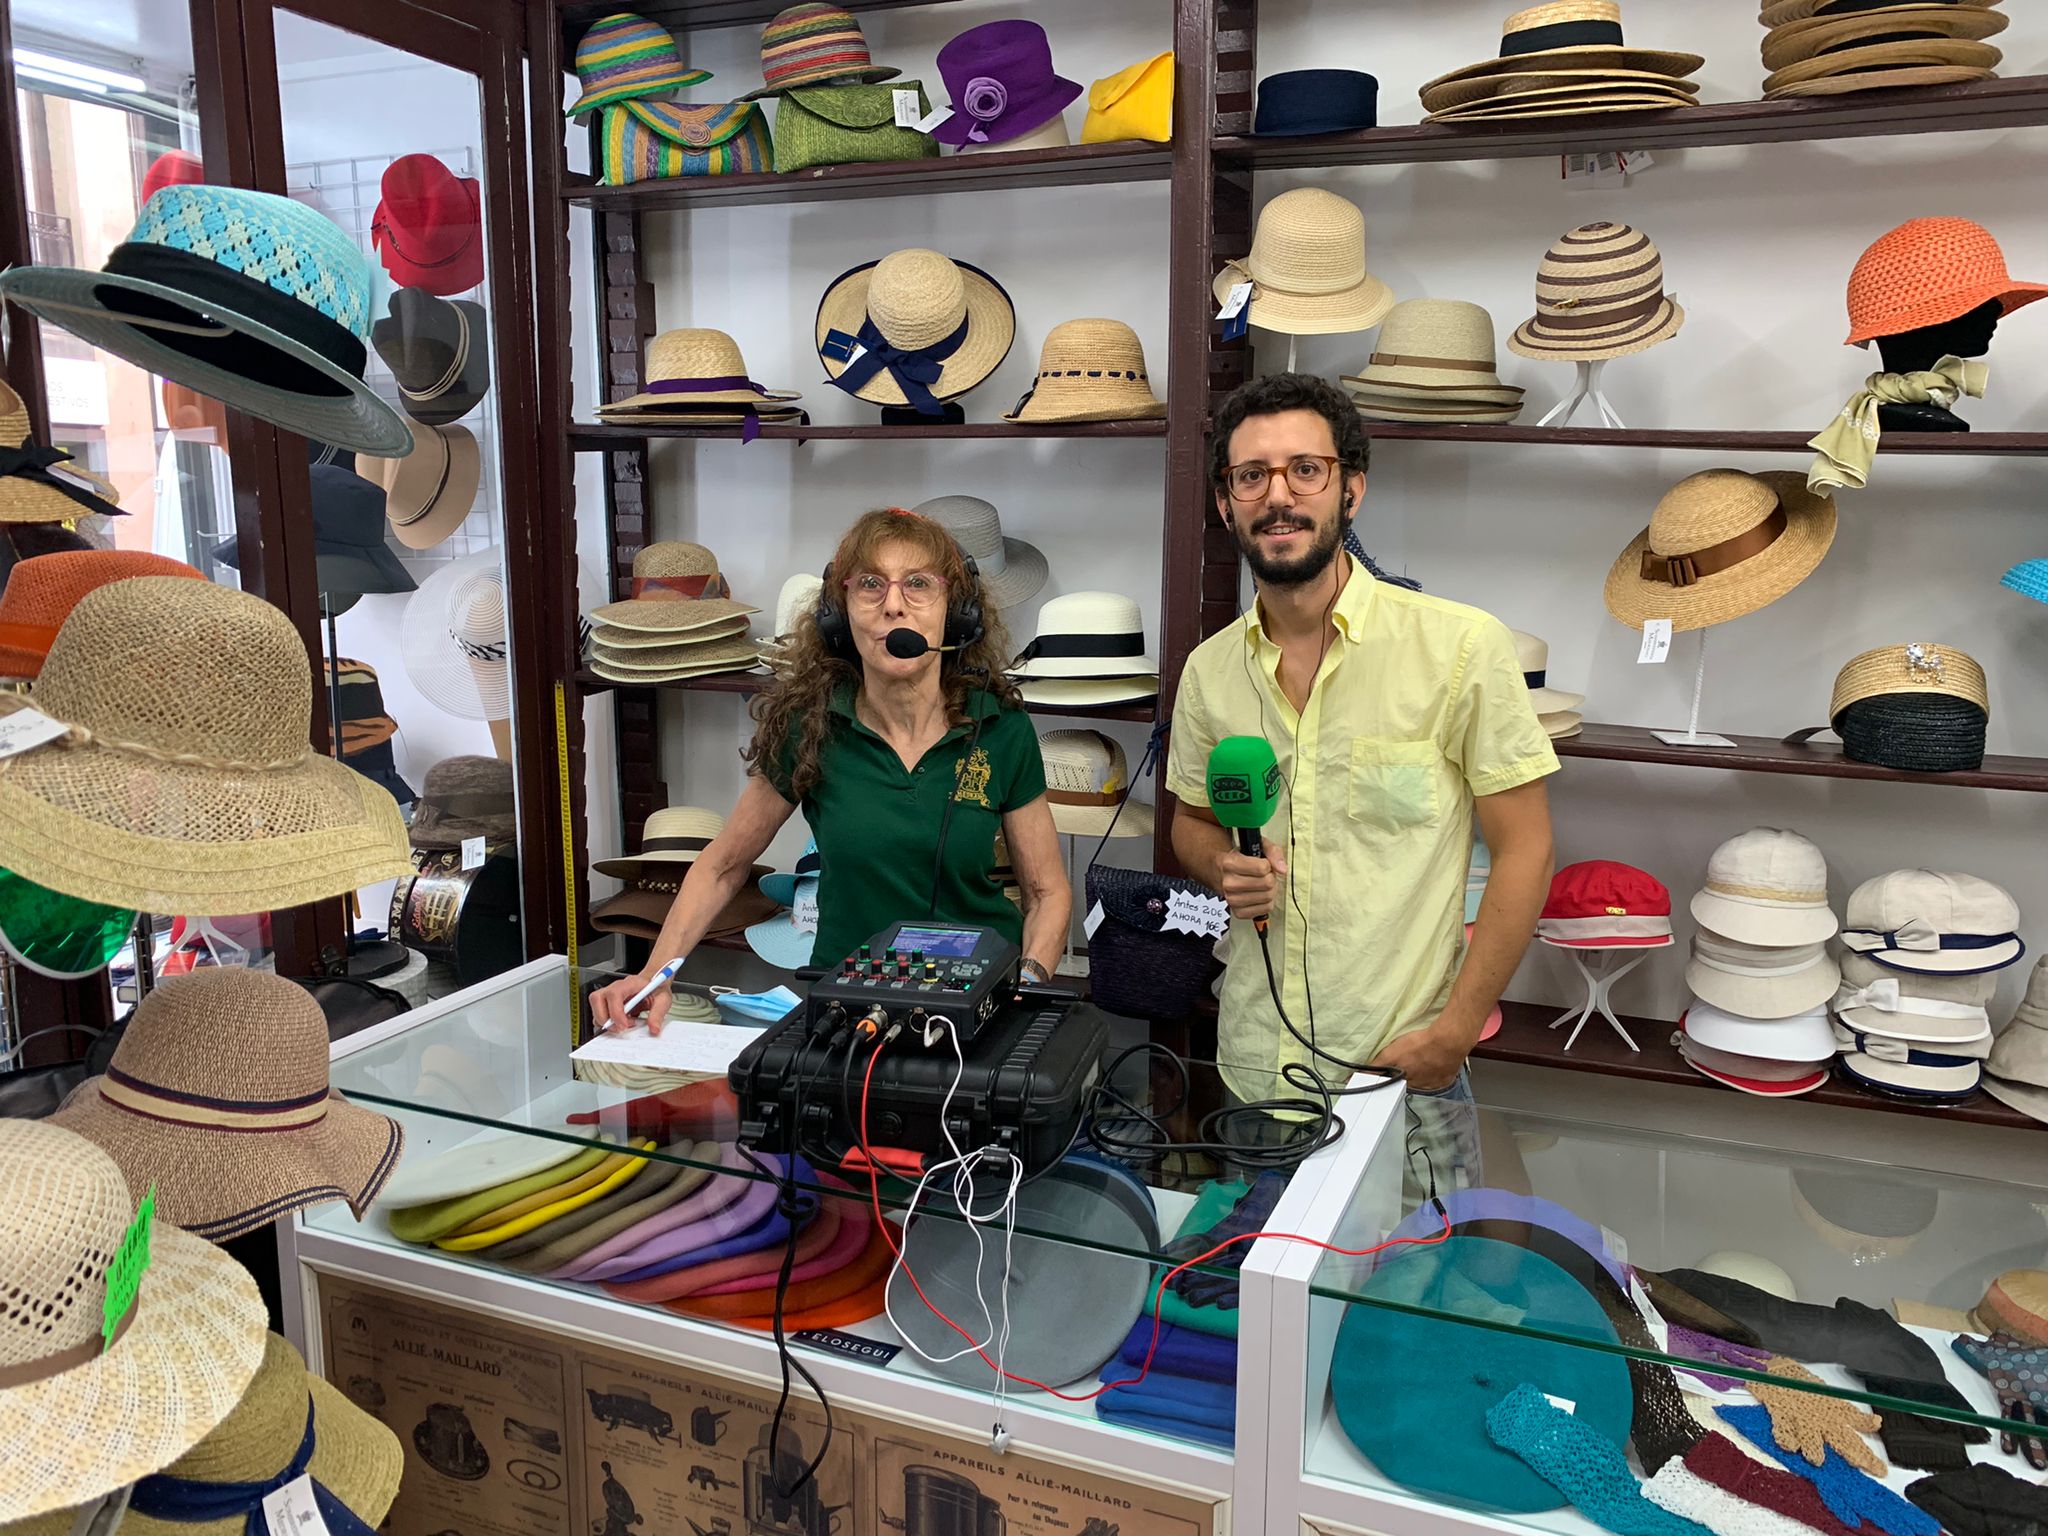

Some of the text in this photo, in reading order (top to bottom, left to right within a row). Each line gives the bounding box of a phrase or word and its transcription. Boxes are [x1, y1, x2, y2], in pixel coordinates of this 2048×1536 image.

[1173, 897, 1199, 911] Antes
[1171, 911, 1202, 925] AHORA
[811, 1333, 890, 1359] ELOSEGUI
[630, 1369, 692, 1394] APPAREILS
[933, 1449, 1006, 1476] APPAREILS
